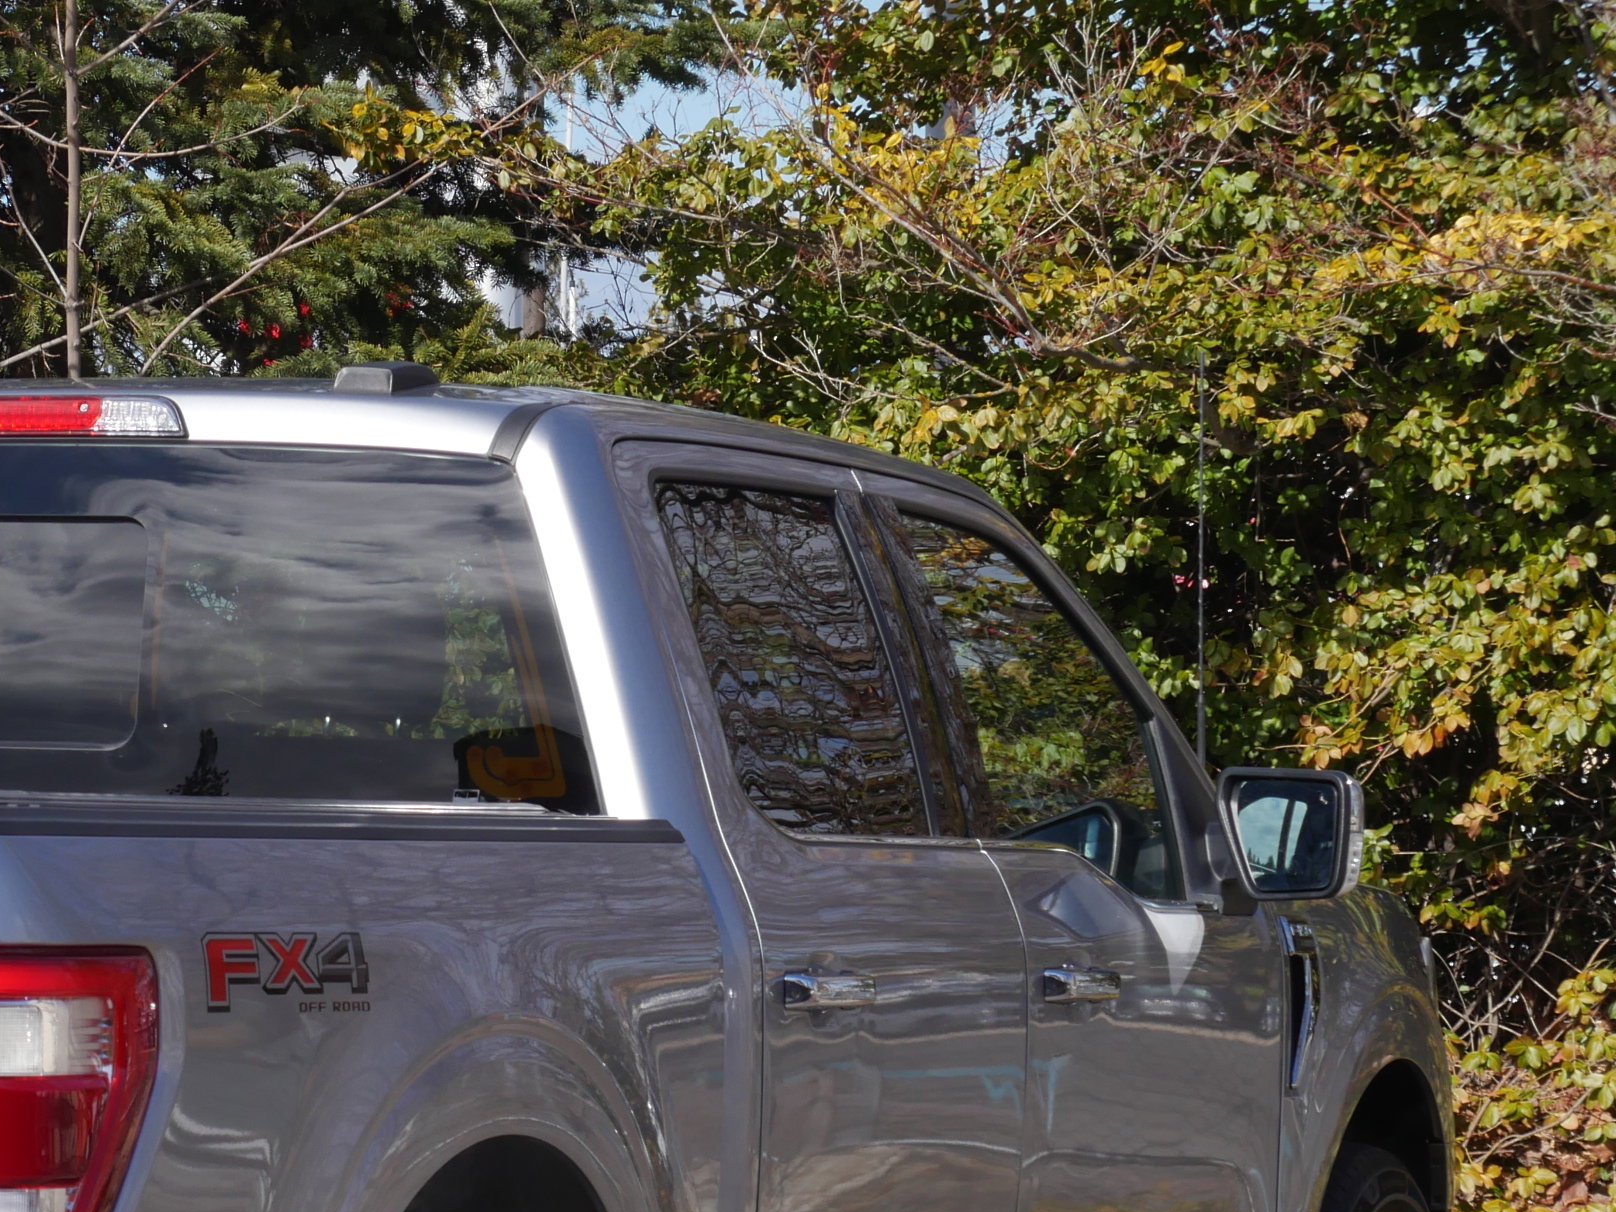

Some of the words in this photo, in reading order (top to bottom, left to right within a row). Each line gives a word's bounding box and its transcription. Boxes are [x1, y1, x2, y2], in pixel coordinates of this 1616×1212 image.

[201, 932, 370, 1013] FX4
[299, 1002, 327, 1013] OFF
[332, 1001, 371, 1012] ROAD
